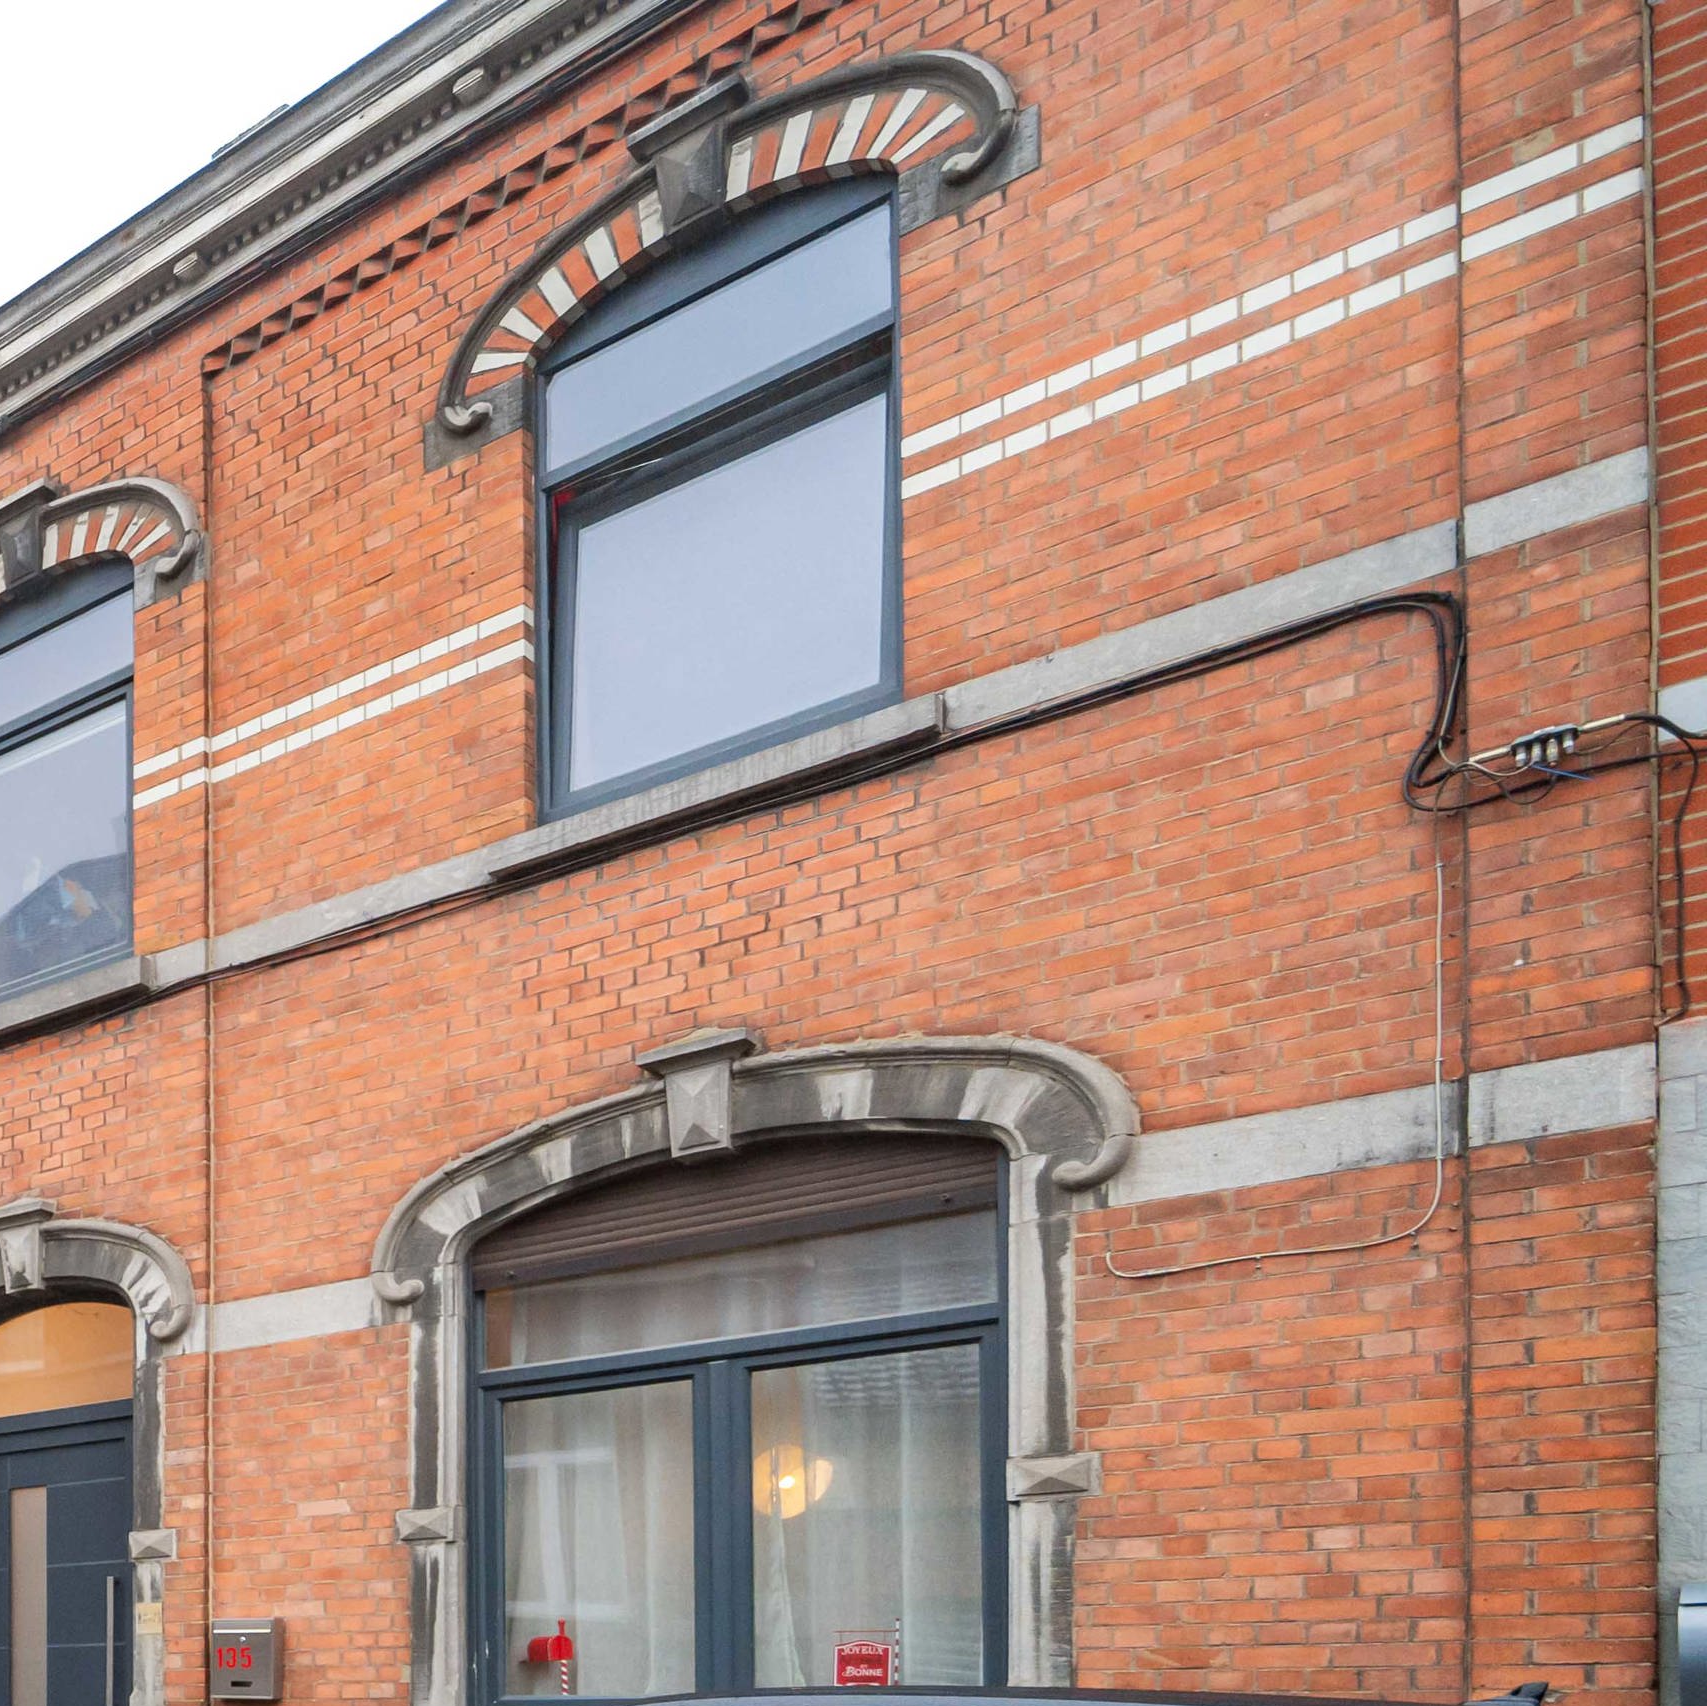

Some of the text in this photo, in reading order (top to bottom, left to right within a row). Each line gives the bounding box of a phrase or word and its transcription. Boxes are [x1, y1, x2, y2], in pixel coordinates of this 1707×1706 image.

[841, 1645, 884, 1656] JOYEUX
[216, 1647, 253, 1670] 135
[841, 1666, 884, 1677] BONNE
